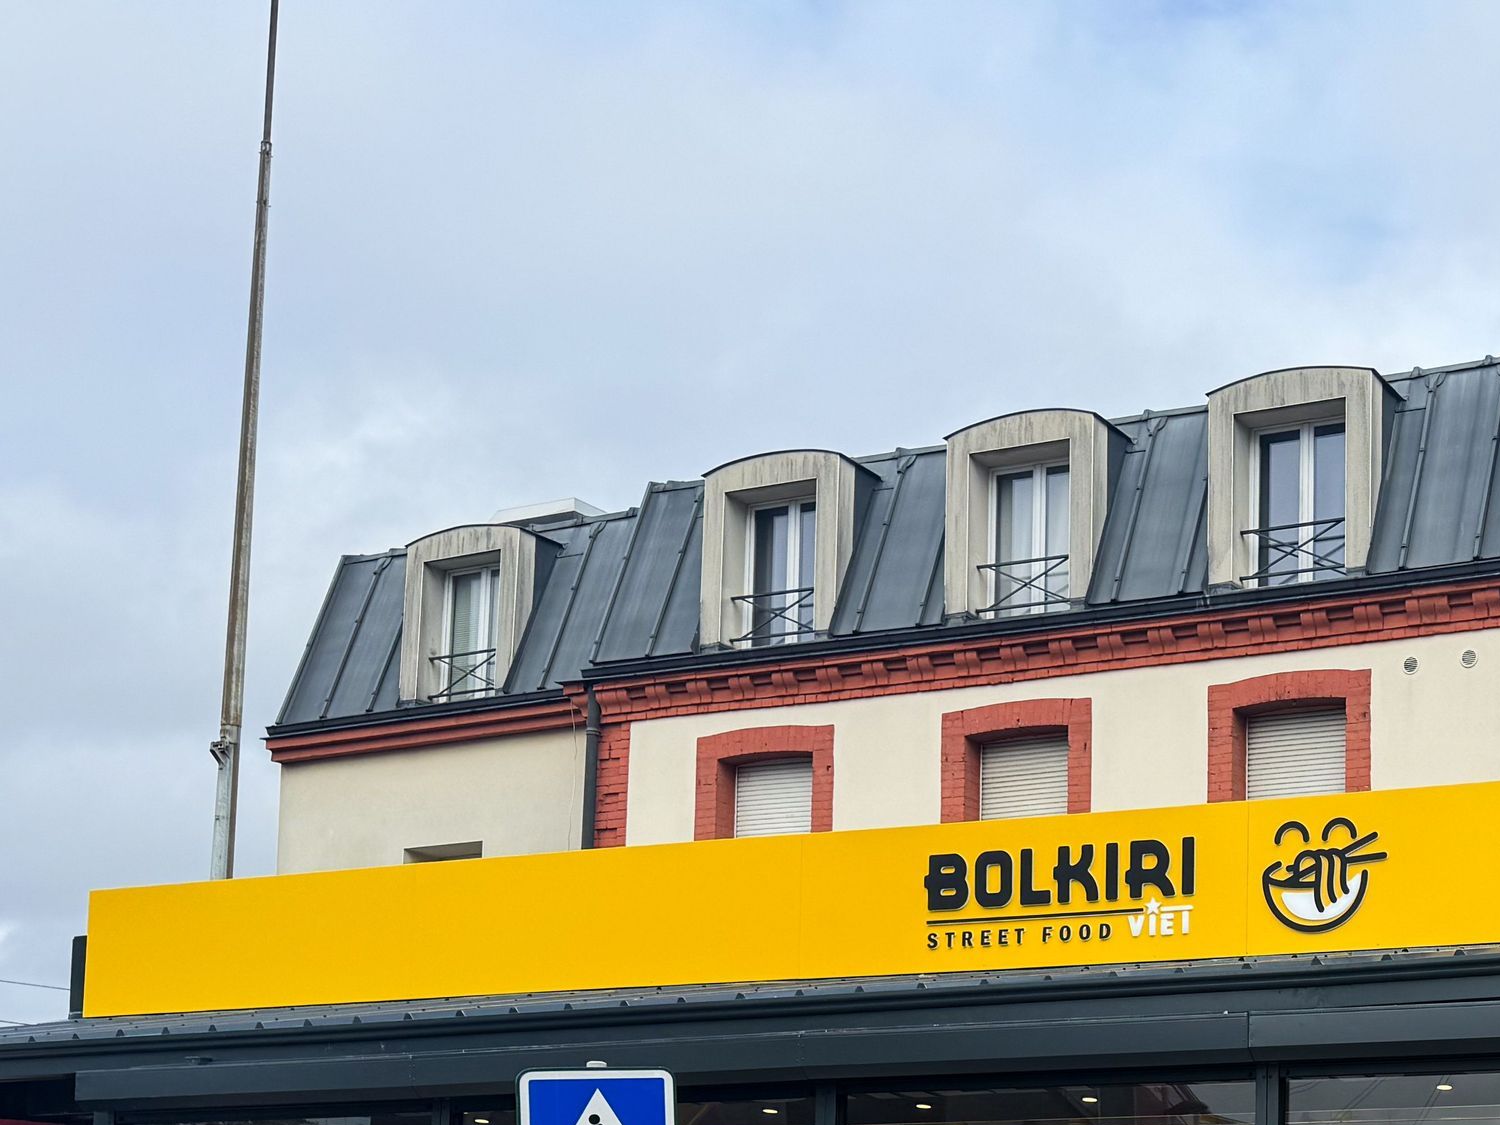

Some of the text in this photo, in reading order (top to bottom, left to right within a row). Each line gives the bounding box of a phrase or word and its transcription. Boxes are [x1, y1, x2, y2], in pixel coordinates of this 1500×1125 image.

[924, 836, 1196, 911] BOLKIRI
[927, 900, 1194, 950] STREET FOOD VIET
